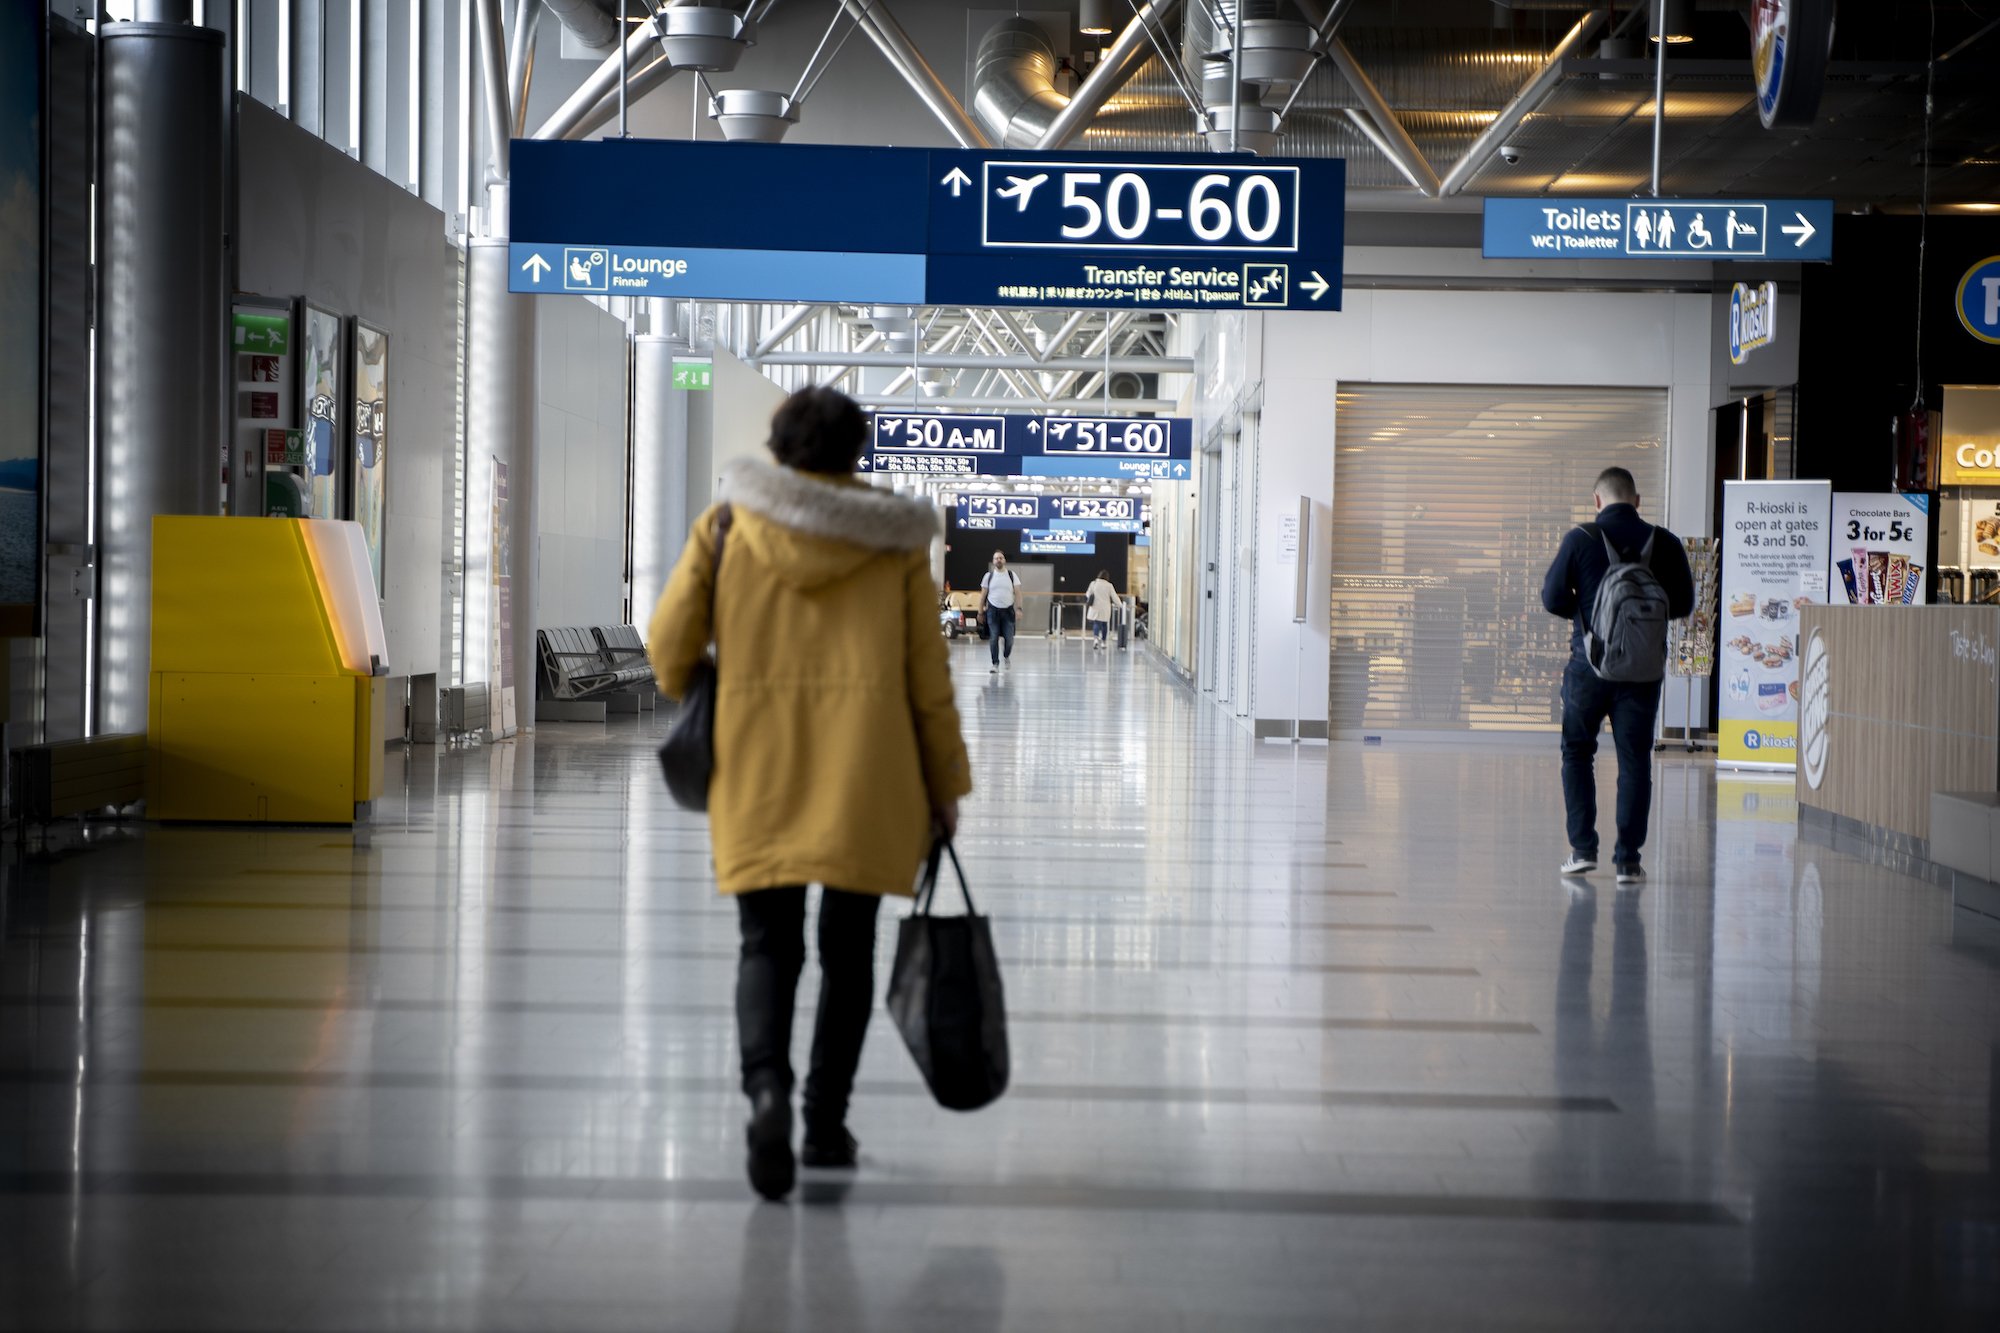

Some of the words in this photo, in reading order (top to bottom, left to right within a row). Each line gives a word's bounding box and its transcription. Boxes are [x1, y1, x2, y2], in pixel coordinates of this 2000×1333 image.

[1061, 172, 1281, 241] 50-60
[1543, 207, 1621, 232] Toilets
[1532, 235, 1554, 248] WC
[1564, 235, 1619, 249] Toaletter
[613, 254, 688, 278] Lounge
[613, 276, 649, 287] Finnair
[1084, 265, 1165, 285] Transfer
[1169, 266, 1239, 287] Service
[906, 419, 944, 448] 50
[947, 429, 996, 449] A-M
[1076, 422, 1164, 452] 51-60
[1119, 461, 1151, 472] Lounge
[986, 498, 1006, 515] 51
[1008, 503, 1033, 515] A-D
[1078, 500, 1129, 517] 52-60
[1747, 502, 1794, 514] R-kioski
[1798, 502, 1808, 514] is
[1849, 509, 1891, 517] Chocolate
[1893, 509, 1910, 518] Bars
[1735, 521, 1767, 532] open
[1770, 520, 1782, 530] at
[1785, 520, 1819, 533] gates
[1847, 520, 1861, 541] 3
[1864, 525, 1885, 541] for
[1889, 520, 1913, 542] 5€
[1744, 535, 1759, 546] 43
[1763, 535, 1786, 547] and
[1790, 535, 1808, 547] 50.
[1747, 733, 1758, 747] R
[1762, 734, 1798, 748] kiosk
